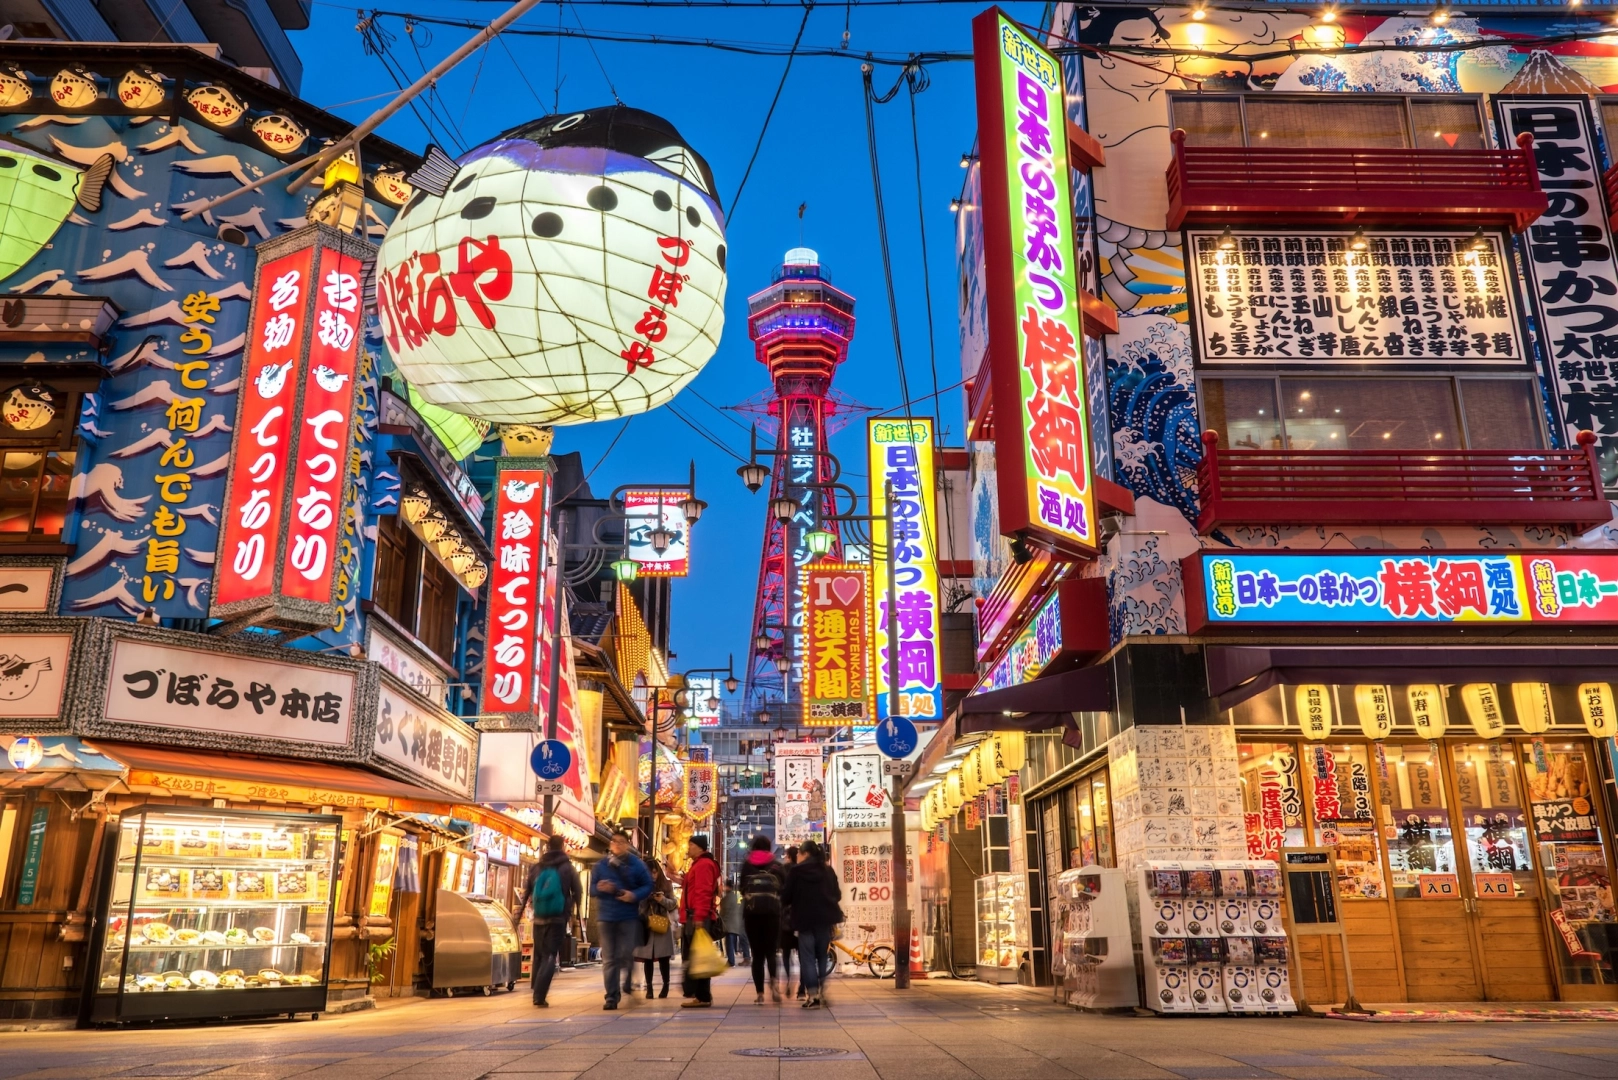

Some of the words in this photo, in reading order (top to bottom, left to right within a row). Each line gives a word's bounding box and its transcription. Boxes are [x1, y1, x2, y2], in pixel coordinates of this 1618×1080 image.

[1002, 25, 1056, 91] 新世界
[1017, 70, 1064, 310] 日本一の串かつ
[621, 236, 695, 375] づぼらや
[1205, 294, 1228, 356] もち
[1226, 295, 1251, 356] うずら玉子
[1247, 295, 1274, 356] 紅しょうが
[1269, 295, 1293, 356] にんにく
[1291, 295, 1316, 356] 玉ねぎ
[1335, 295, 1361, 356] しし唐
[1356, 295, 1383, 356] れんこん
[1377, 295, 1405, 356] 銀杏
[1400, 296, 1426, 356] 白ねぎ
[1422, 296, 1448, 356] さつま芋
[1443, 296, 1470, 356] じゃが芋
[1464, 296, 1491, 356] 茄子
[1486, 296, 1513, 356] 椎茸
[1022, 306, 1085, 491] 横綱
[874, 423, 927, 442] 新世界
[234, 406, 284, 581] てっちり
[291, 409, 344, 581] てっちり
[886, 446, 923, 586] 日本一の串かつ
[1040, 486, 1087, 536] 酒処
[492, 509, 535, 705] 珍味てっちり
[814, 577, 832, 606] I
[1213, 561, 1235, 616] 新世界
[1237, 573, 1378, 606] 日本一の串かつ
[1380, 561, 1488, 617] 横綱
[1485, 562, 1519, 616] 酒処
[1533, 562, 1559, 615] 新世界
[813, 608, 848, 699] 通天閣
[849, 608, 862, 698] TSUTENKAKU
[879, 590, 935, 689] 横綱
[123, 668, 343, 725] づぼらや本店
[831, 702, 863, 717] 横綱
[1308, 689, 1324, 731] 自慢の逸品
[1414, 699, 1430, 727] 寿司
[1588, 695, 1604, 729] お造り
[376, 698, 469, 788] ふぐ料理専門
[151, 776, 227, 794] ふぐなら日本一
[308, 792, 376, 807] ふぐなら日本一
[699, 769, 712, 803] 串かつ
[1260, 771, 1285, 850] 二度漬け
[1280, 758, 1299, 814] ソースの
[1417, 766, 1432, 805] 白ねぎ
[1533, 803, 1573, 819] 串かつ
[843, 845, 912, 856] 元祖串カツ専店
[846, 820, 887, 828] 座敷あります
[1402, 819, 1437, 872] 横綱
[1481, 819, 1517, 871] 横綱
[27, 868, 34, 877] 5
[1428, 883, 1452, 894] 入口
[1483, 883, 1508, 894] 入口
